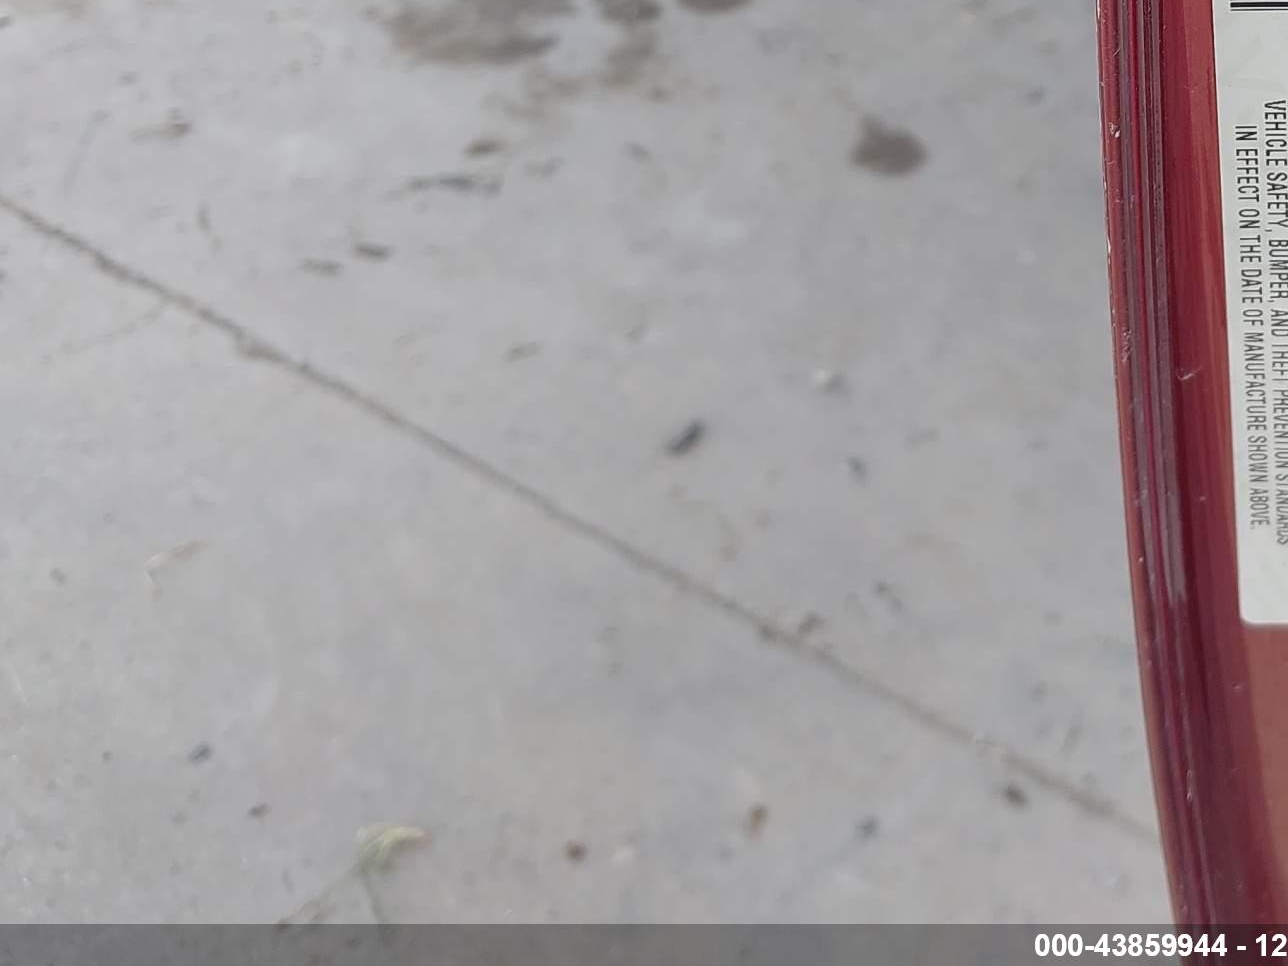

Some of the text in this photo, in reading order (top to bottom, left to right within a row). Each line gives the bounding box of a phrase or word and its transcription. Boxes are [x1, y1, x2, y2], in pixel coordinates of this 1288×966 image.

[1265, 100, 1287, 166] VEHICLE
[1265, 173, 1288, 232] SAFETY,
[1235, 126, 1270, 529] IN EFFECT ON THE DATE OF MANUFACTURE SHOWN ABOVE.
